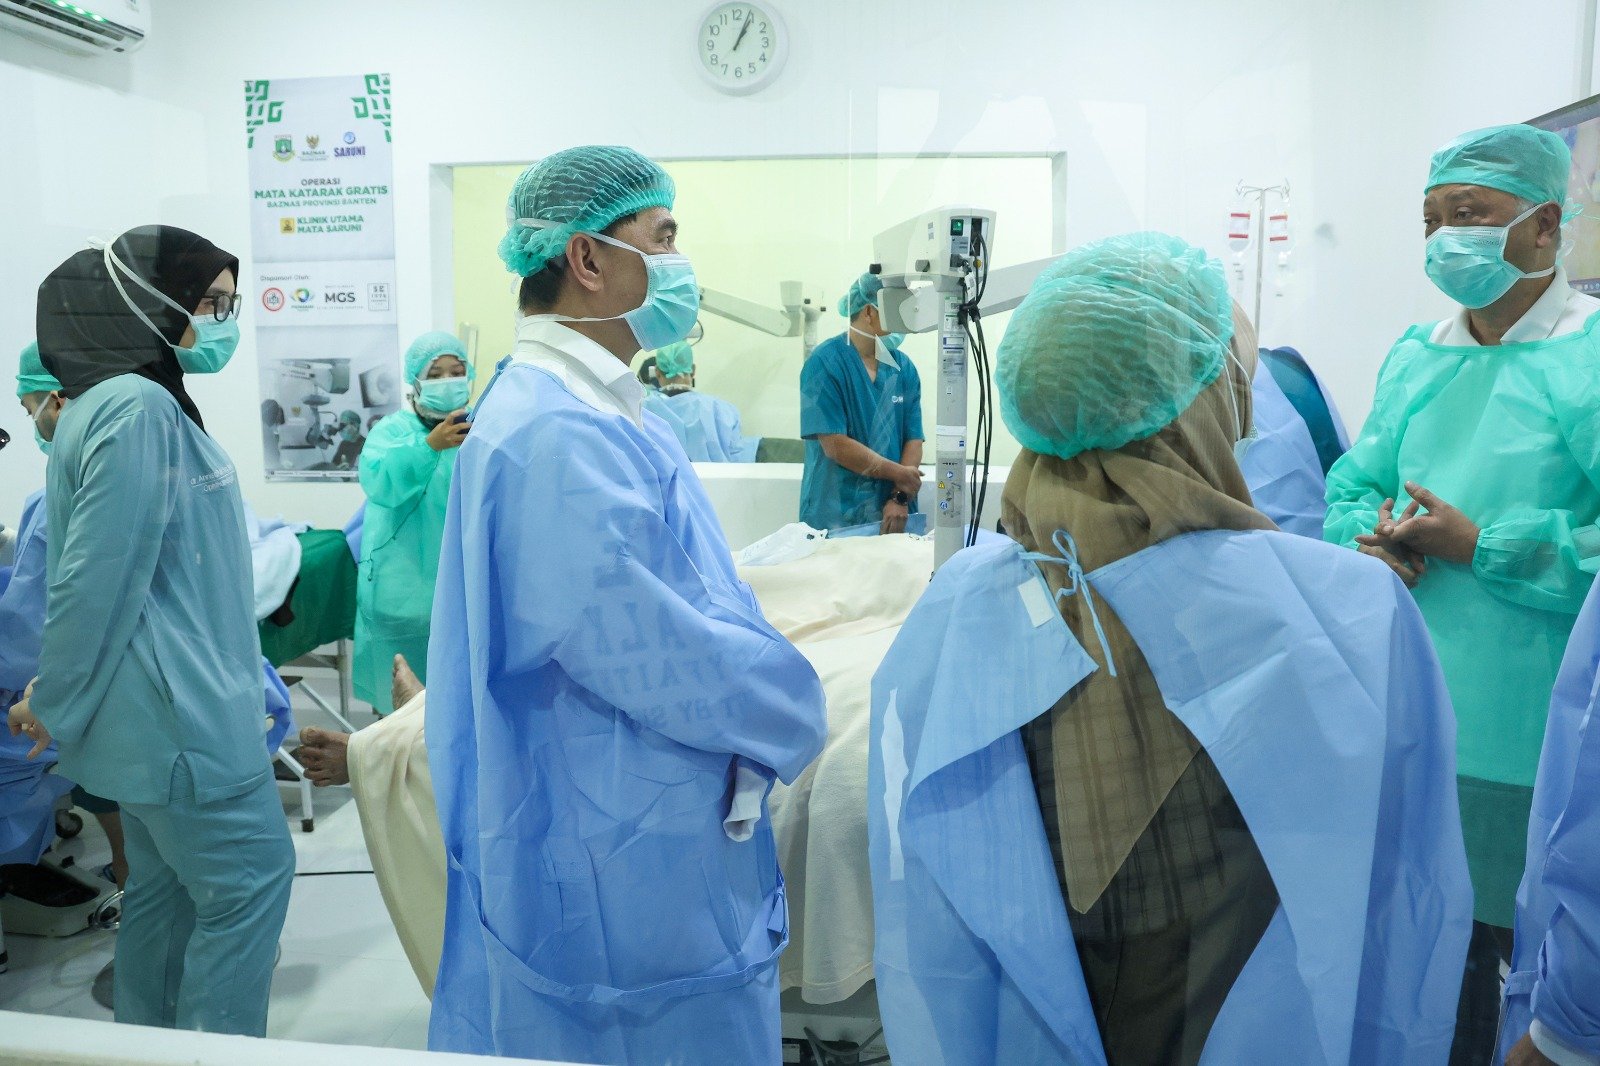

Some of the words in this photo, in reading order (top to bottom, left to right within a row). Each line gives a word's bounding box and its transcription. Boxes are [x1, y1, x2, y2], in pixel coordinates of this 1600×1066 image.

[720, 14, 727, 25] 11
[732, 9, 742, 20] 12
[709, 25, 720, 35] 10
[759, 22, 766, 33] 2
[706, 40, 714, 51] 9
[761, 37, 769, 48] 3
[710, 54, 718, 65] 8
[759, 53, 766, 62] 4
[721, 64, 728, 75] 7
[734, 67, 742, 78] 6
[748, 62, 756, 74] 5
[334, 146, 366, 158] SARUNI
[301, 178, 341, 186] OPERASI
[254, 189, 286, 199] MATA
[289, 187, 343, 198] KATARAK
[346, 185, 388, 195] GRATIS
[267, 200, 301, 208] BAZNAS
[303, 199, 341, 207] PROVINSI
[342, 198, 376, 206] BANTEN
[297, 215, 328, 225] KLINIK
[330, 215, 364, 223] UTAMA
[297, 224, 324, 234] MATA
[326, 224, 362, 233] SARUNI
[325, 291, 356, 303] MGS
